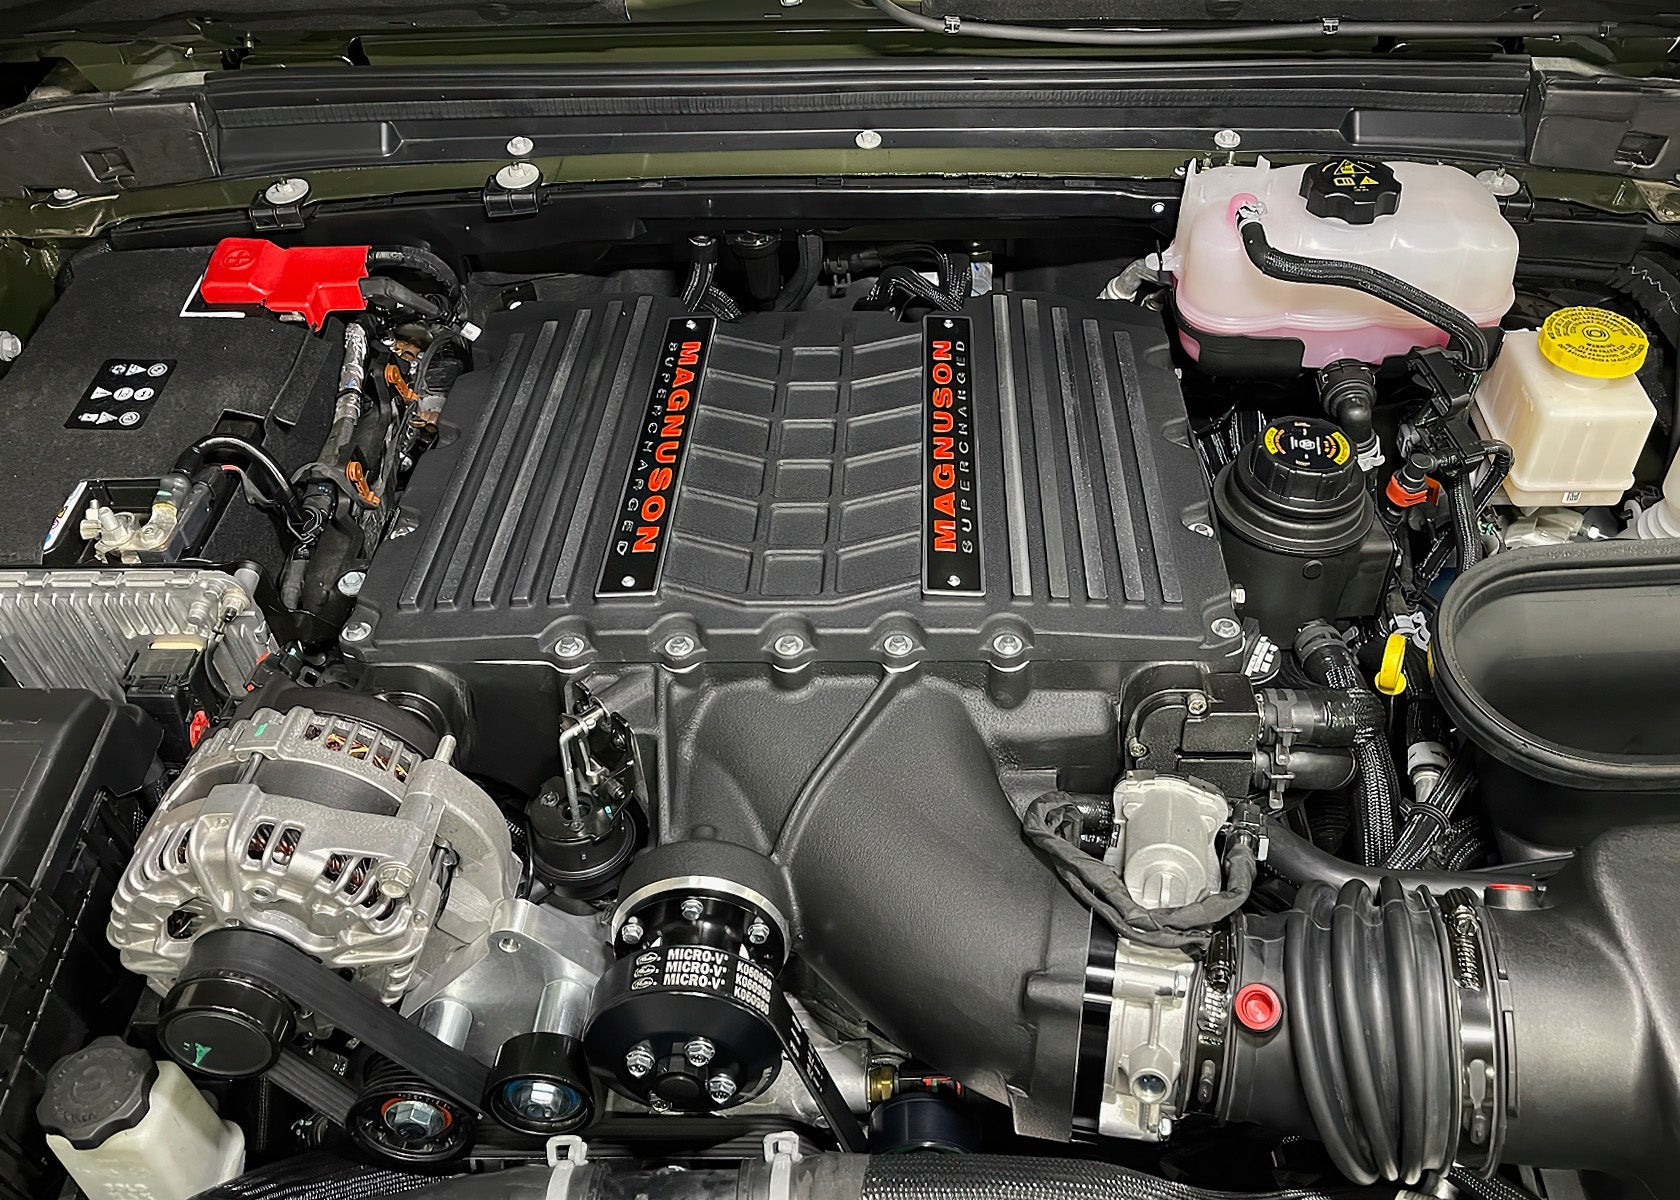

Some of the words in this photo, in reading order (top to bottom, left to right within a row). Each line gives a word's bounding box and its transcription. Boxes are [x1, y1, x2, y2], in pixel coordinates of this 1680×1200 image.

[617, 342, 678, 556] SUPERCHARGED
[632, 341, 702, 553] MAGNUSON
[932, 340, 957, 552] MAGNUSON
[955, 341, 973, 554] SUPERCHARGED
